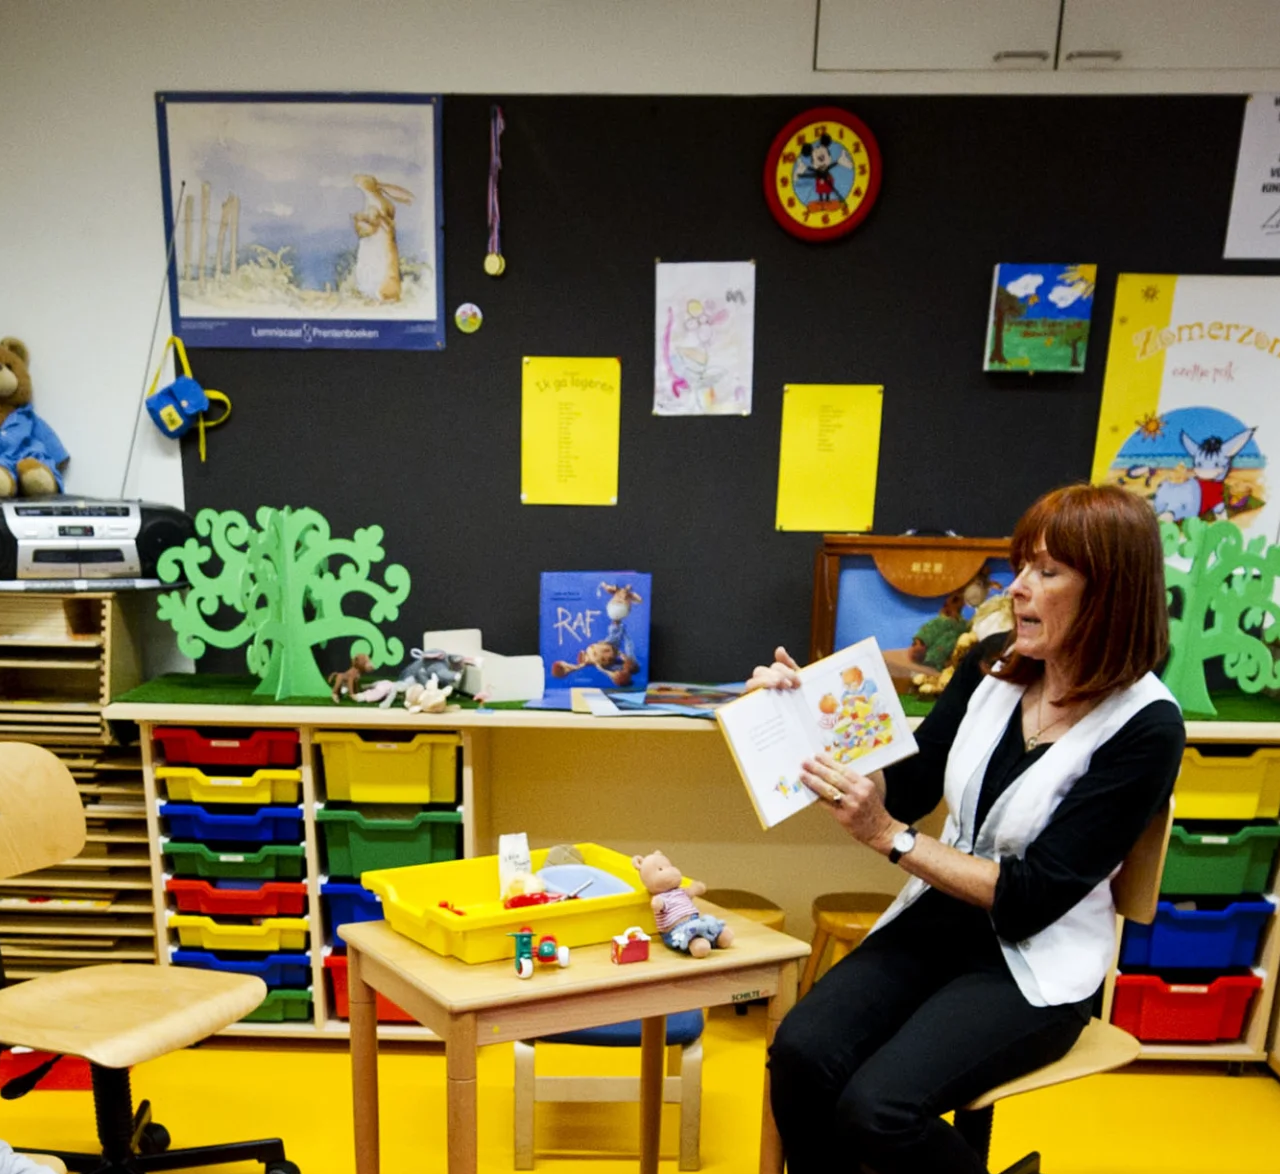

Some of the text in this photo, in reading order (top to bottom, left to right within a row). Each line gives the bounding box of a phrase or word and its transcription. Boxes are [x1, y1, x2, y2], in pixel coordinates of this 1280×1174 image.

[250, 326, 303, 338] Lemniscaat
[570, 374, 615, 395] logeren
[553, 606, 601, 646] RAF
